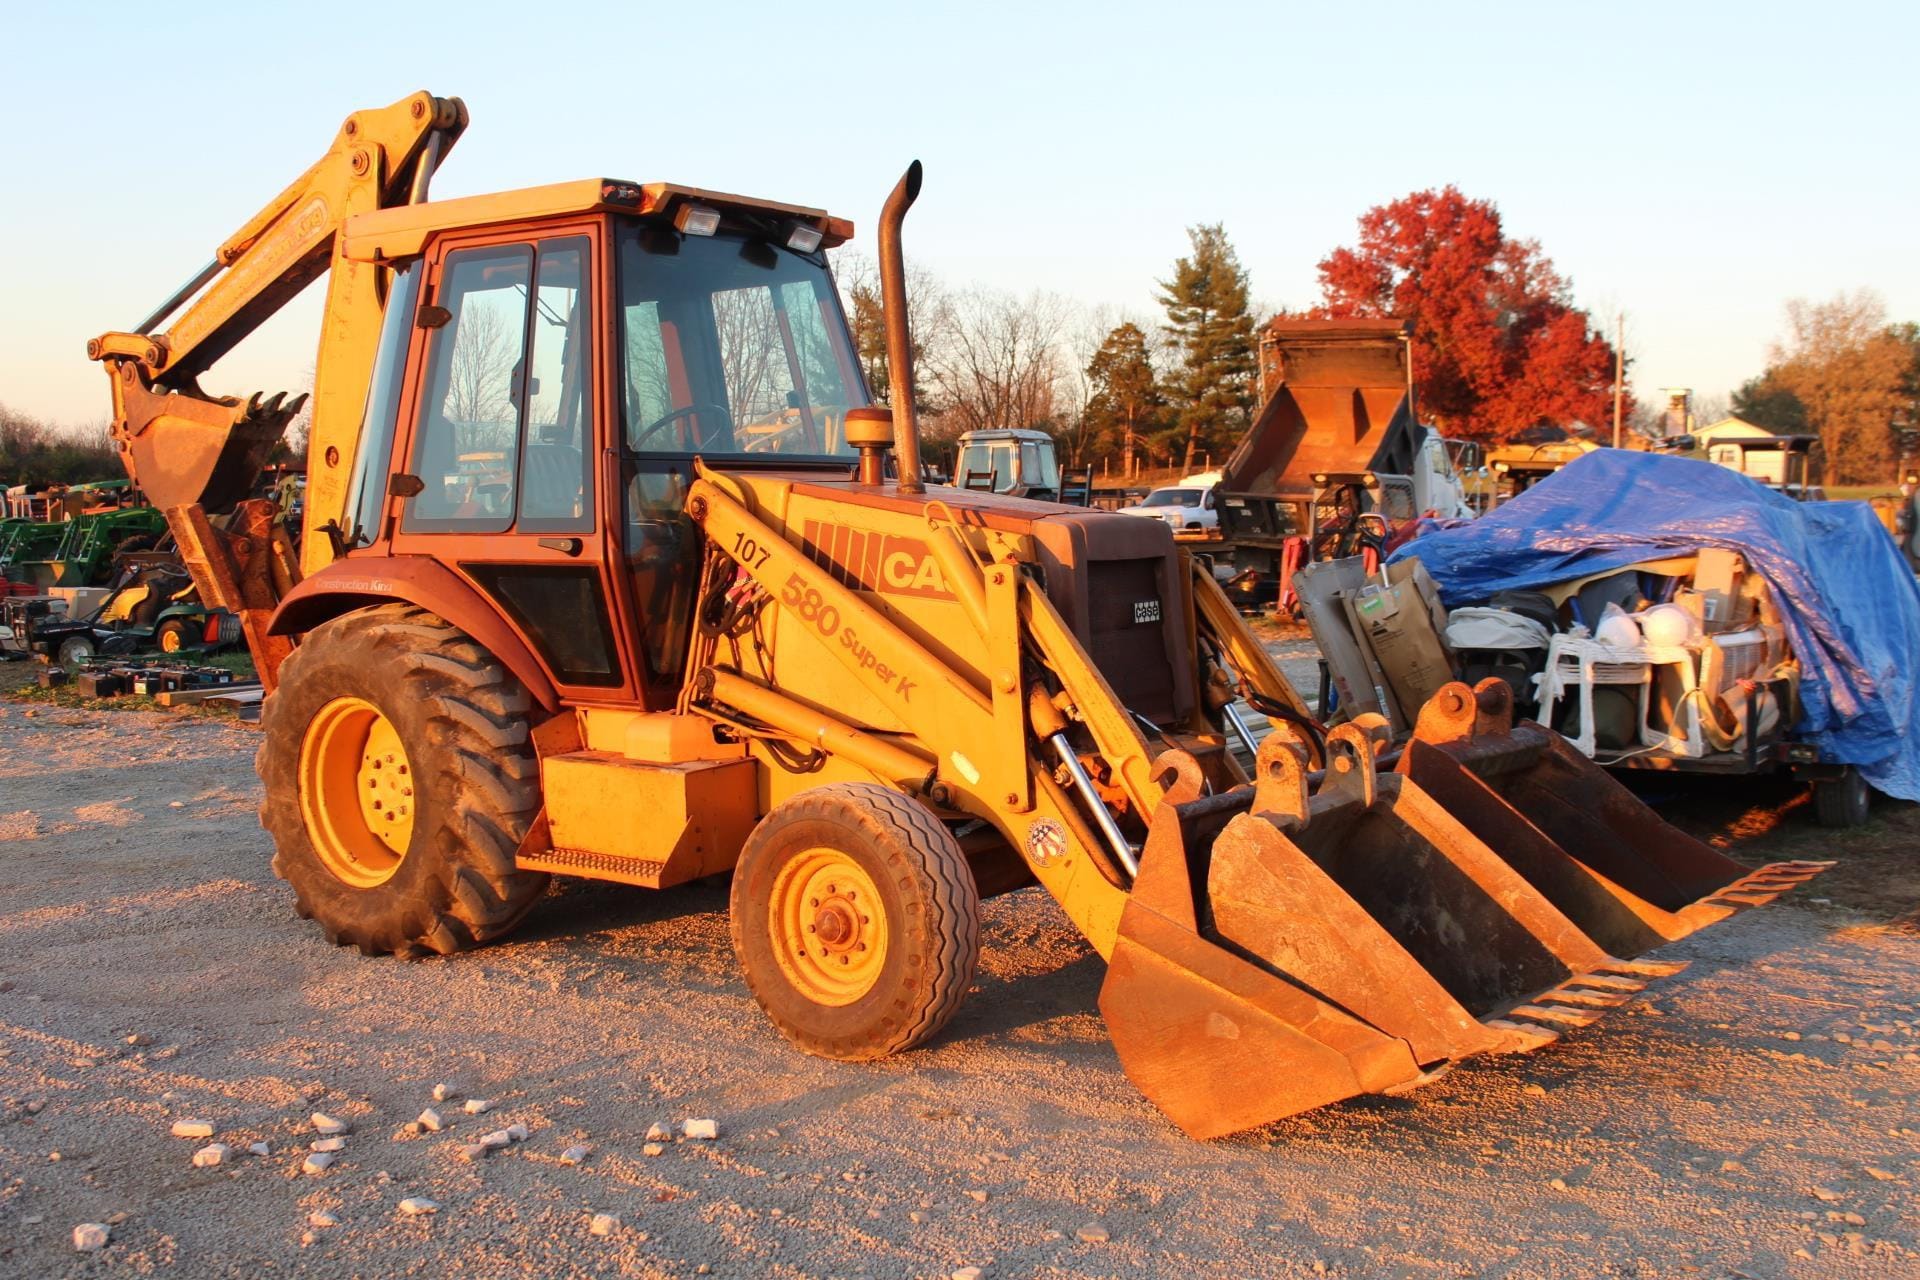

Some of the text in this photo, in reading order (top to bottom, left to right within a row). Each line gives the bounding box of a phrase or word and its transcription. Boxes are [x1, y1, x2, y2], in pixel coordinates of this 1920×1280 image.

[734, 531, 771, 570] 107
[883, 551, 955, 594] CA
[781, 572, 917, 704] 580 Super K
